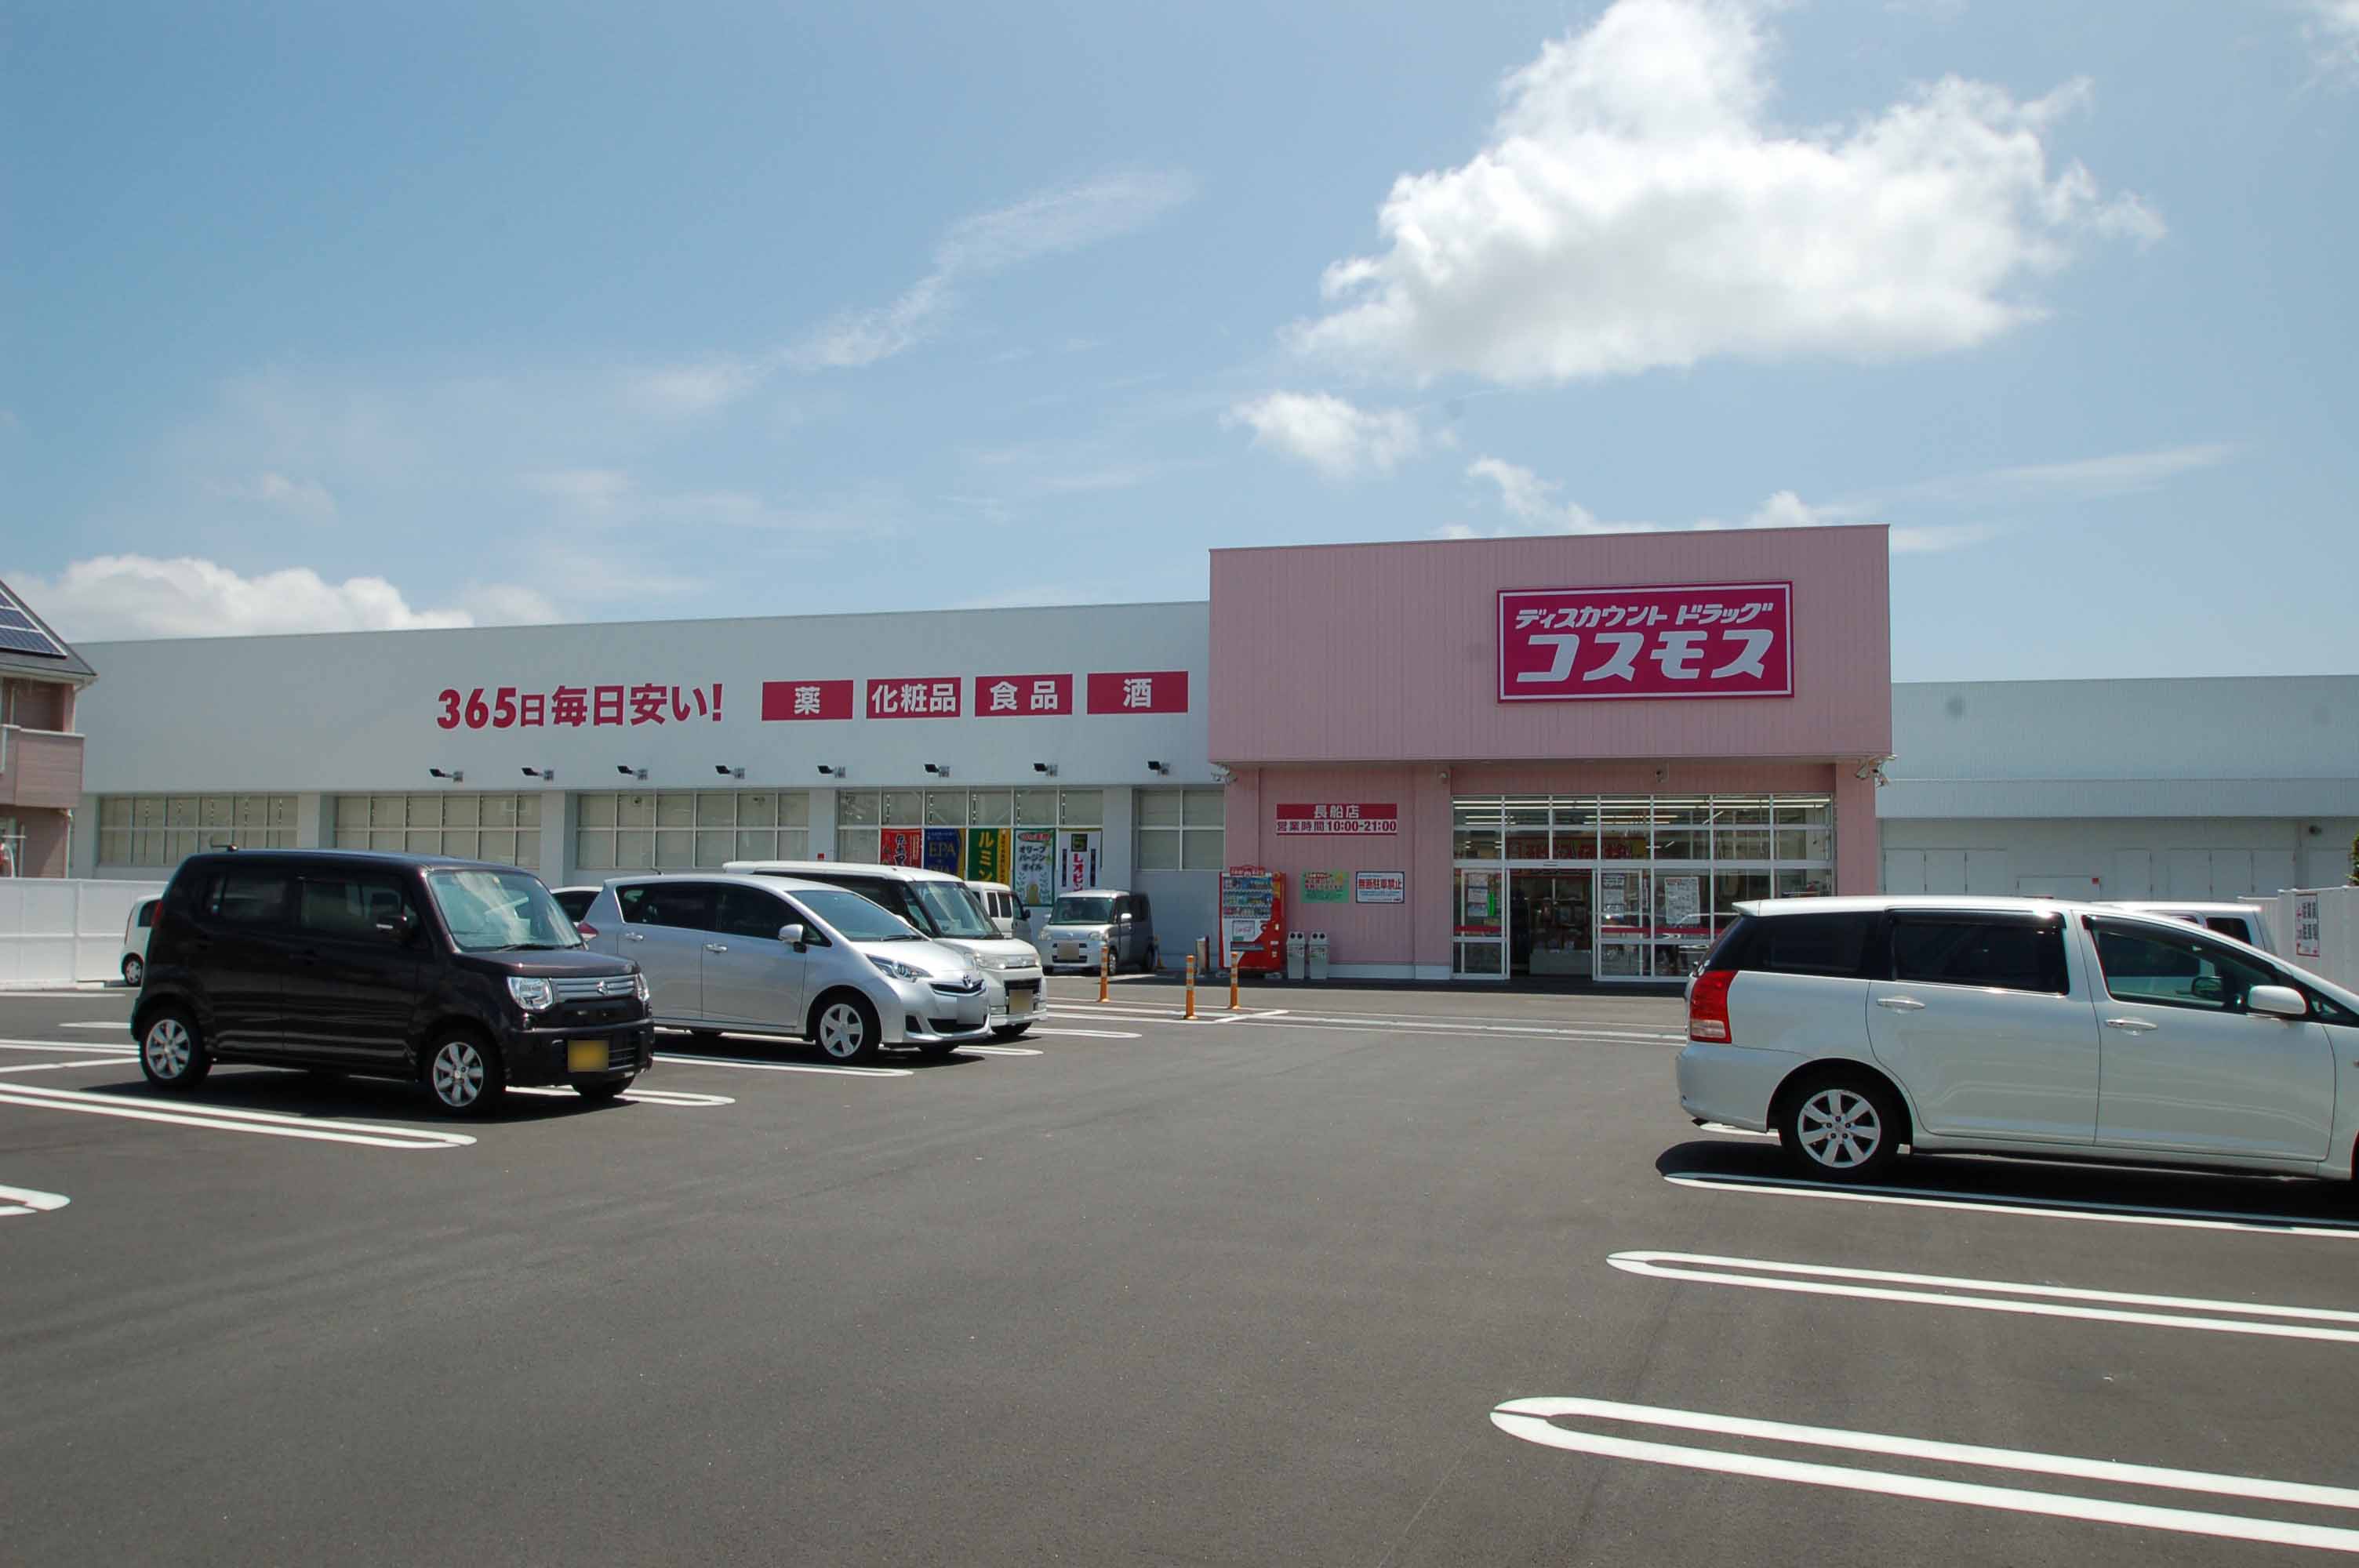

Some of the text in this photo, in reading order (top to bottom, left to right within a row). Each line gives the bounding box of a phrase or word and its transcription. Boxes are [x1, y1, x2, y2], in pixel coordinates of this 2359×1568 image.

[1514, 601, 1775, 630] ディスカウント ドラッグ
[1516, 628, 1775, 683] コスモス
[793, 685, 822, 715] 薬
[871, 682, 958, 714] 化粧品
[989, 680, 1060, 712] 食品
[1122, 677, 1153, 709] 酒
[1314, 804, 1360, 819] 長船店
[929, 840, 956, 858] EPA
